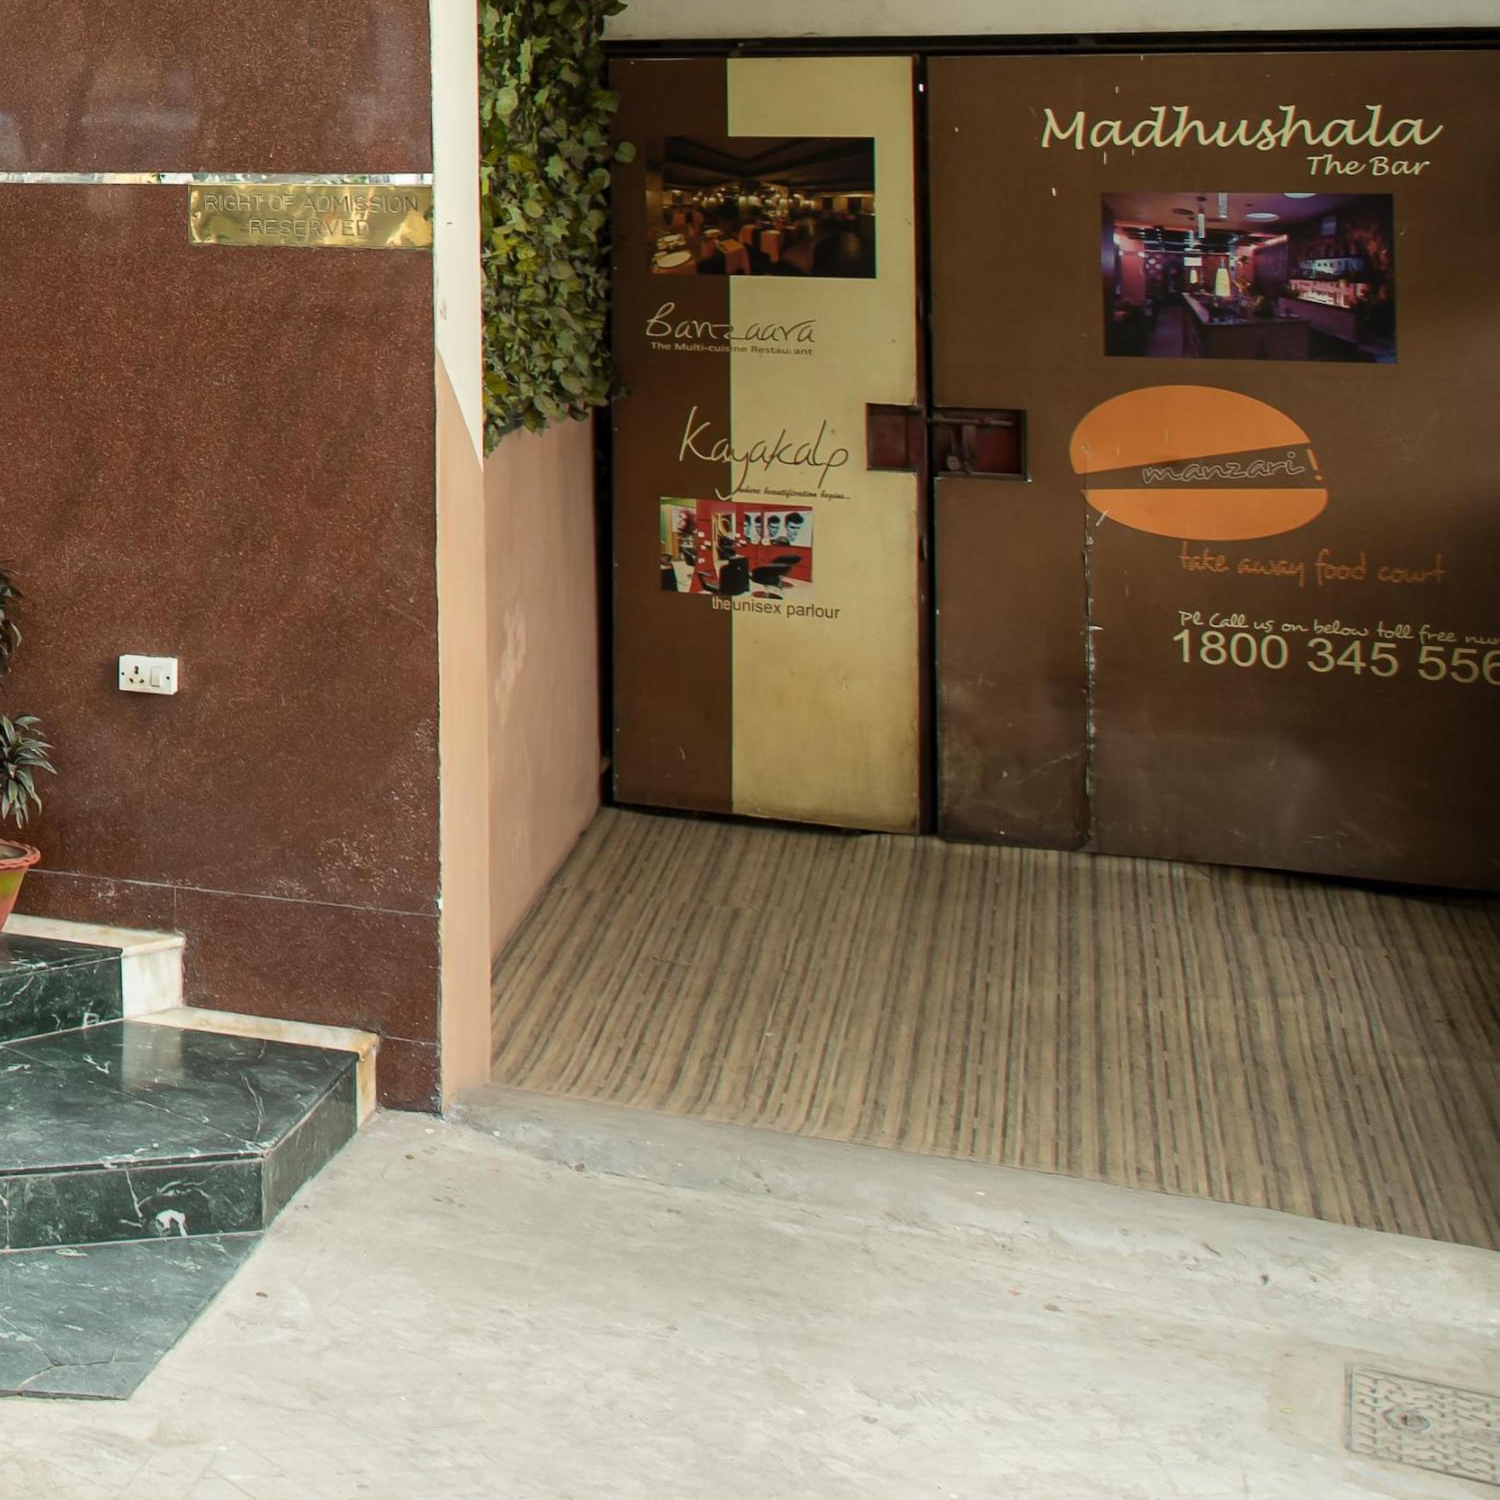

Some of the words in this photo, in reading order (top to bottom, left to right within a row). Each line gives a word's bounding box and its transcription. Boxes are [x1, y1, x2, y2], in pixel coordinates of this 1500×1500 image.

[1040, 105, 1444, 153] Madhushala
[1306, 155, 1361, 177] The
[1372, 155, 1431, 177] Bar
[203, 194, 266, 211] RIGHT
[268, 195, 296, 211] OF
[303, 195, 420, 213] ADMISSION
[250, 219, 371, 237] RESERVED
[645, 302, 817, 343] Banzaara
[650, 341, 671, 351] The
[678, 405, 849, 501] Kayakalp
[1142, 451, 1306, 484] manzari
[1180, 541, 1229, 574] take
[1237, 558, 1305, 588] away
[1314, 548, 1367, 586] food
[1377, 553, 1446, 584] court
[711, 596, 731, 611] the
[733, 598, 781, 615] unisex
[786, 603, 841, 619] parlour
[1208, 613, 1249, 630] Call
[1253, 620, 1273, 633] us
[1281, 622, 1308, 633] on
[1313, 618, 1369, 638] below
[1377, 621, 1415, 640] toll
[1418, 624, 1457, 645] free
[1172, 628, 1289, 670] 1800
[1307, 637, 1399, 678] 345
